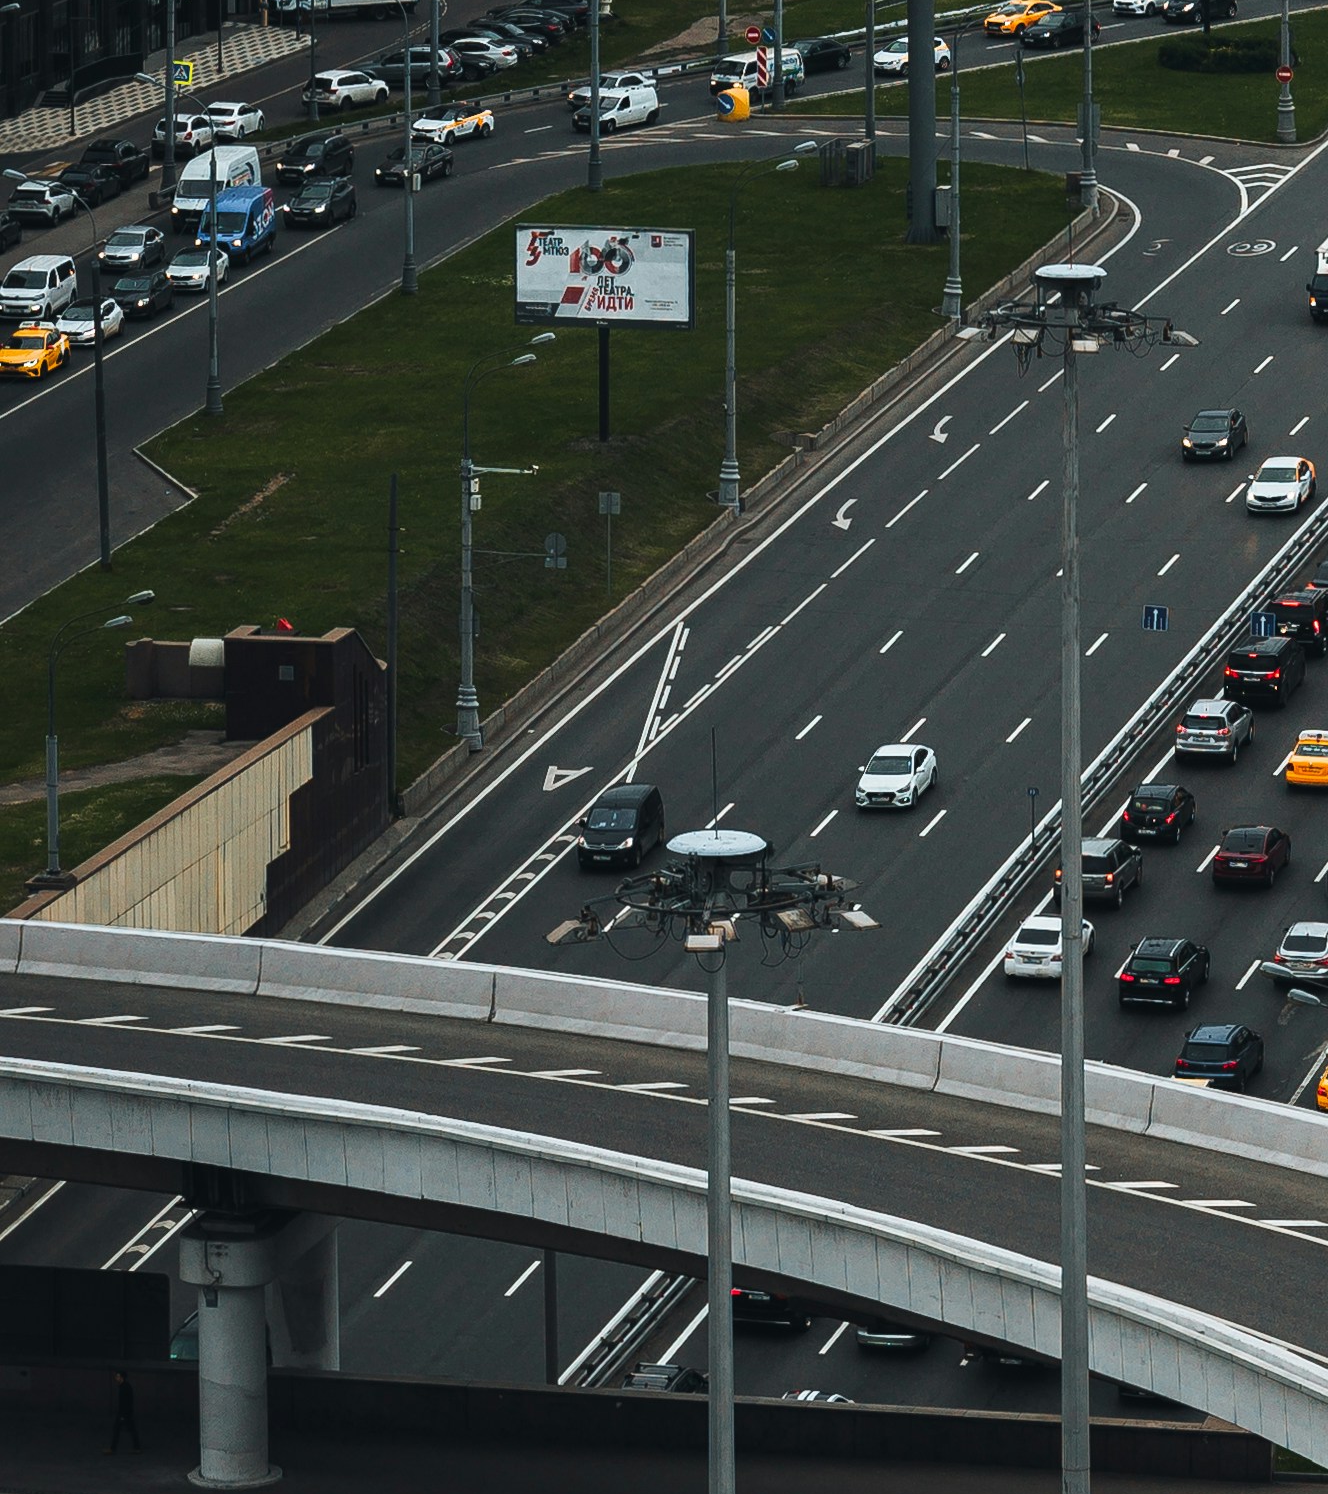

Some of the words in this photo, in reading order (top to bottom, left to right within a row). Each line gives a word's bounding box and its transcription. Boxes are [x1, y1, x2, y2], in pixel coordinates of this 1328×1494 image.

[538, 237, 563, 247] ТЕАТР
[543, 245, 569, 256] МТЮЗ
[597, 276, 615, 286] ЛЕТ
[597, 296, 633, 312] ИДТИ
